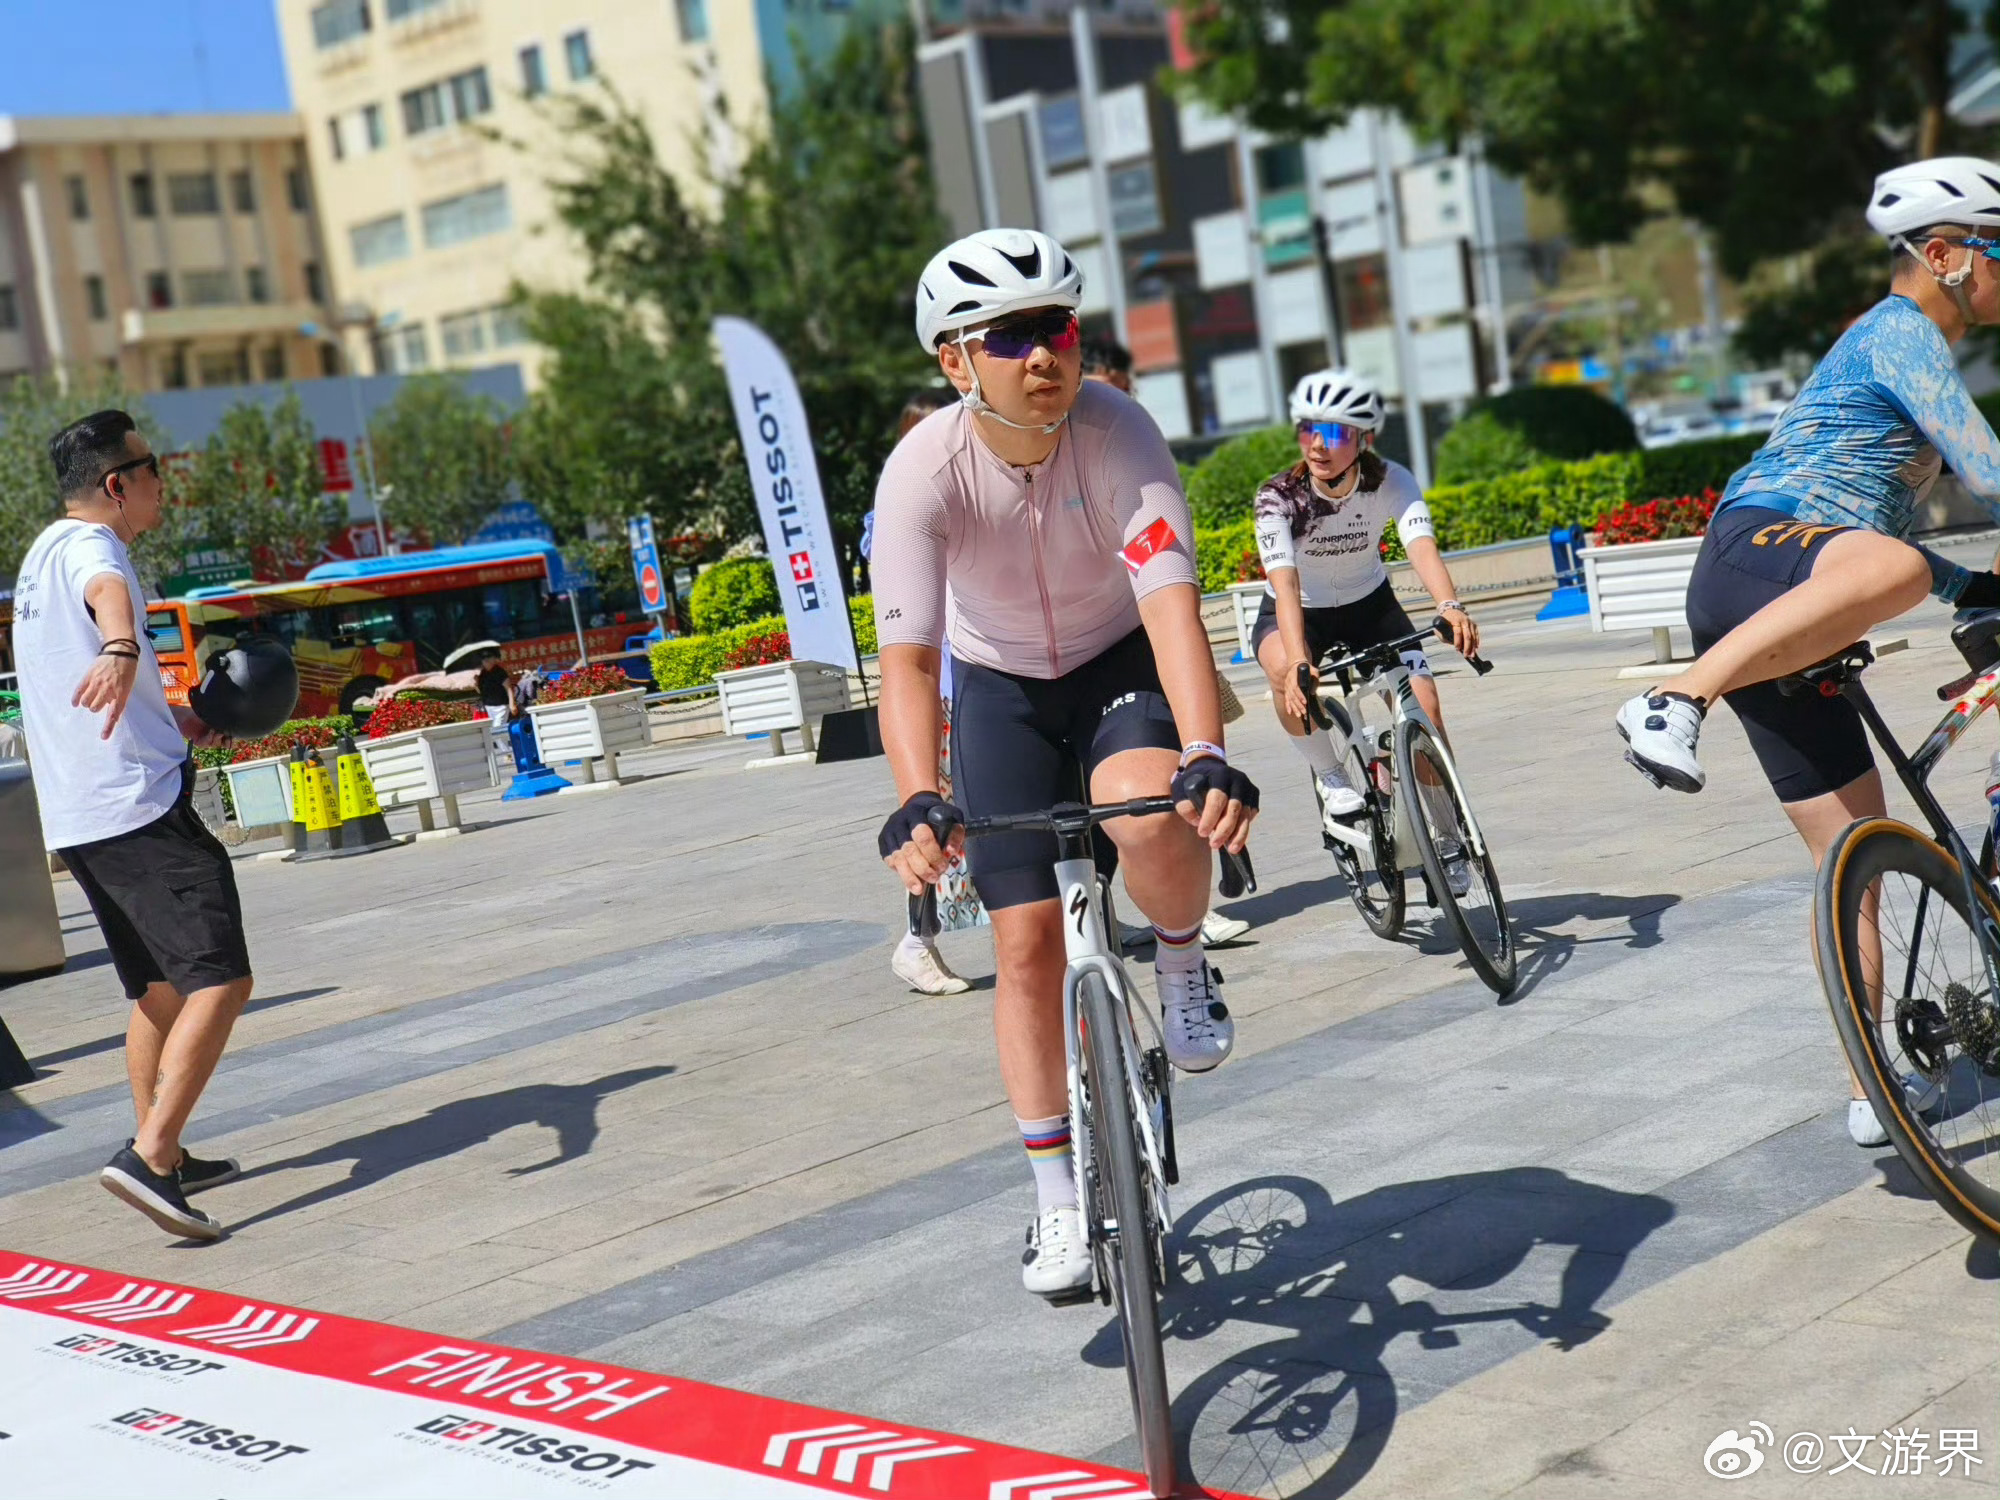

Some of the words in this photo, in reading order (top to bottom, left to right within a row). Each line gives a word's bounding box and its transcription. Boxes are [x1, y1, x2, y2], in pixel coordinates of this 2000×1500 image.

[750, 385, 803, 548] TISSOT
[1309, 531, 1368, 543] SUNRIMOON
[97, 1342, 227, 1376] TISSOT
[368, 1345, 672, 1422] FINISH
[161, 1419, 310, 1463] TISSOT
[479, 1427, 656, 1479] TISSOT
